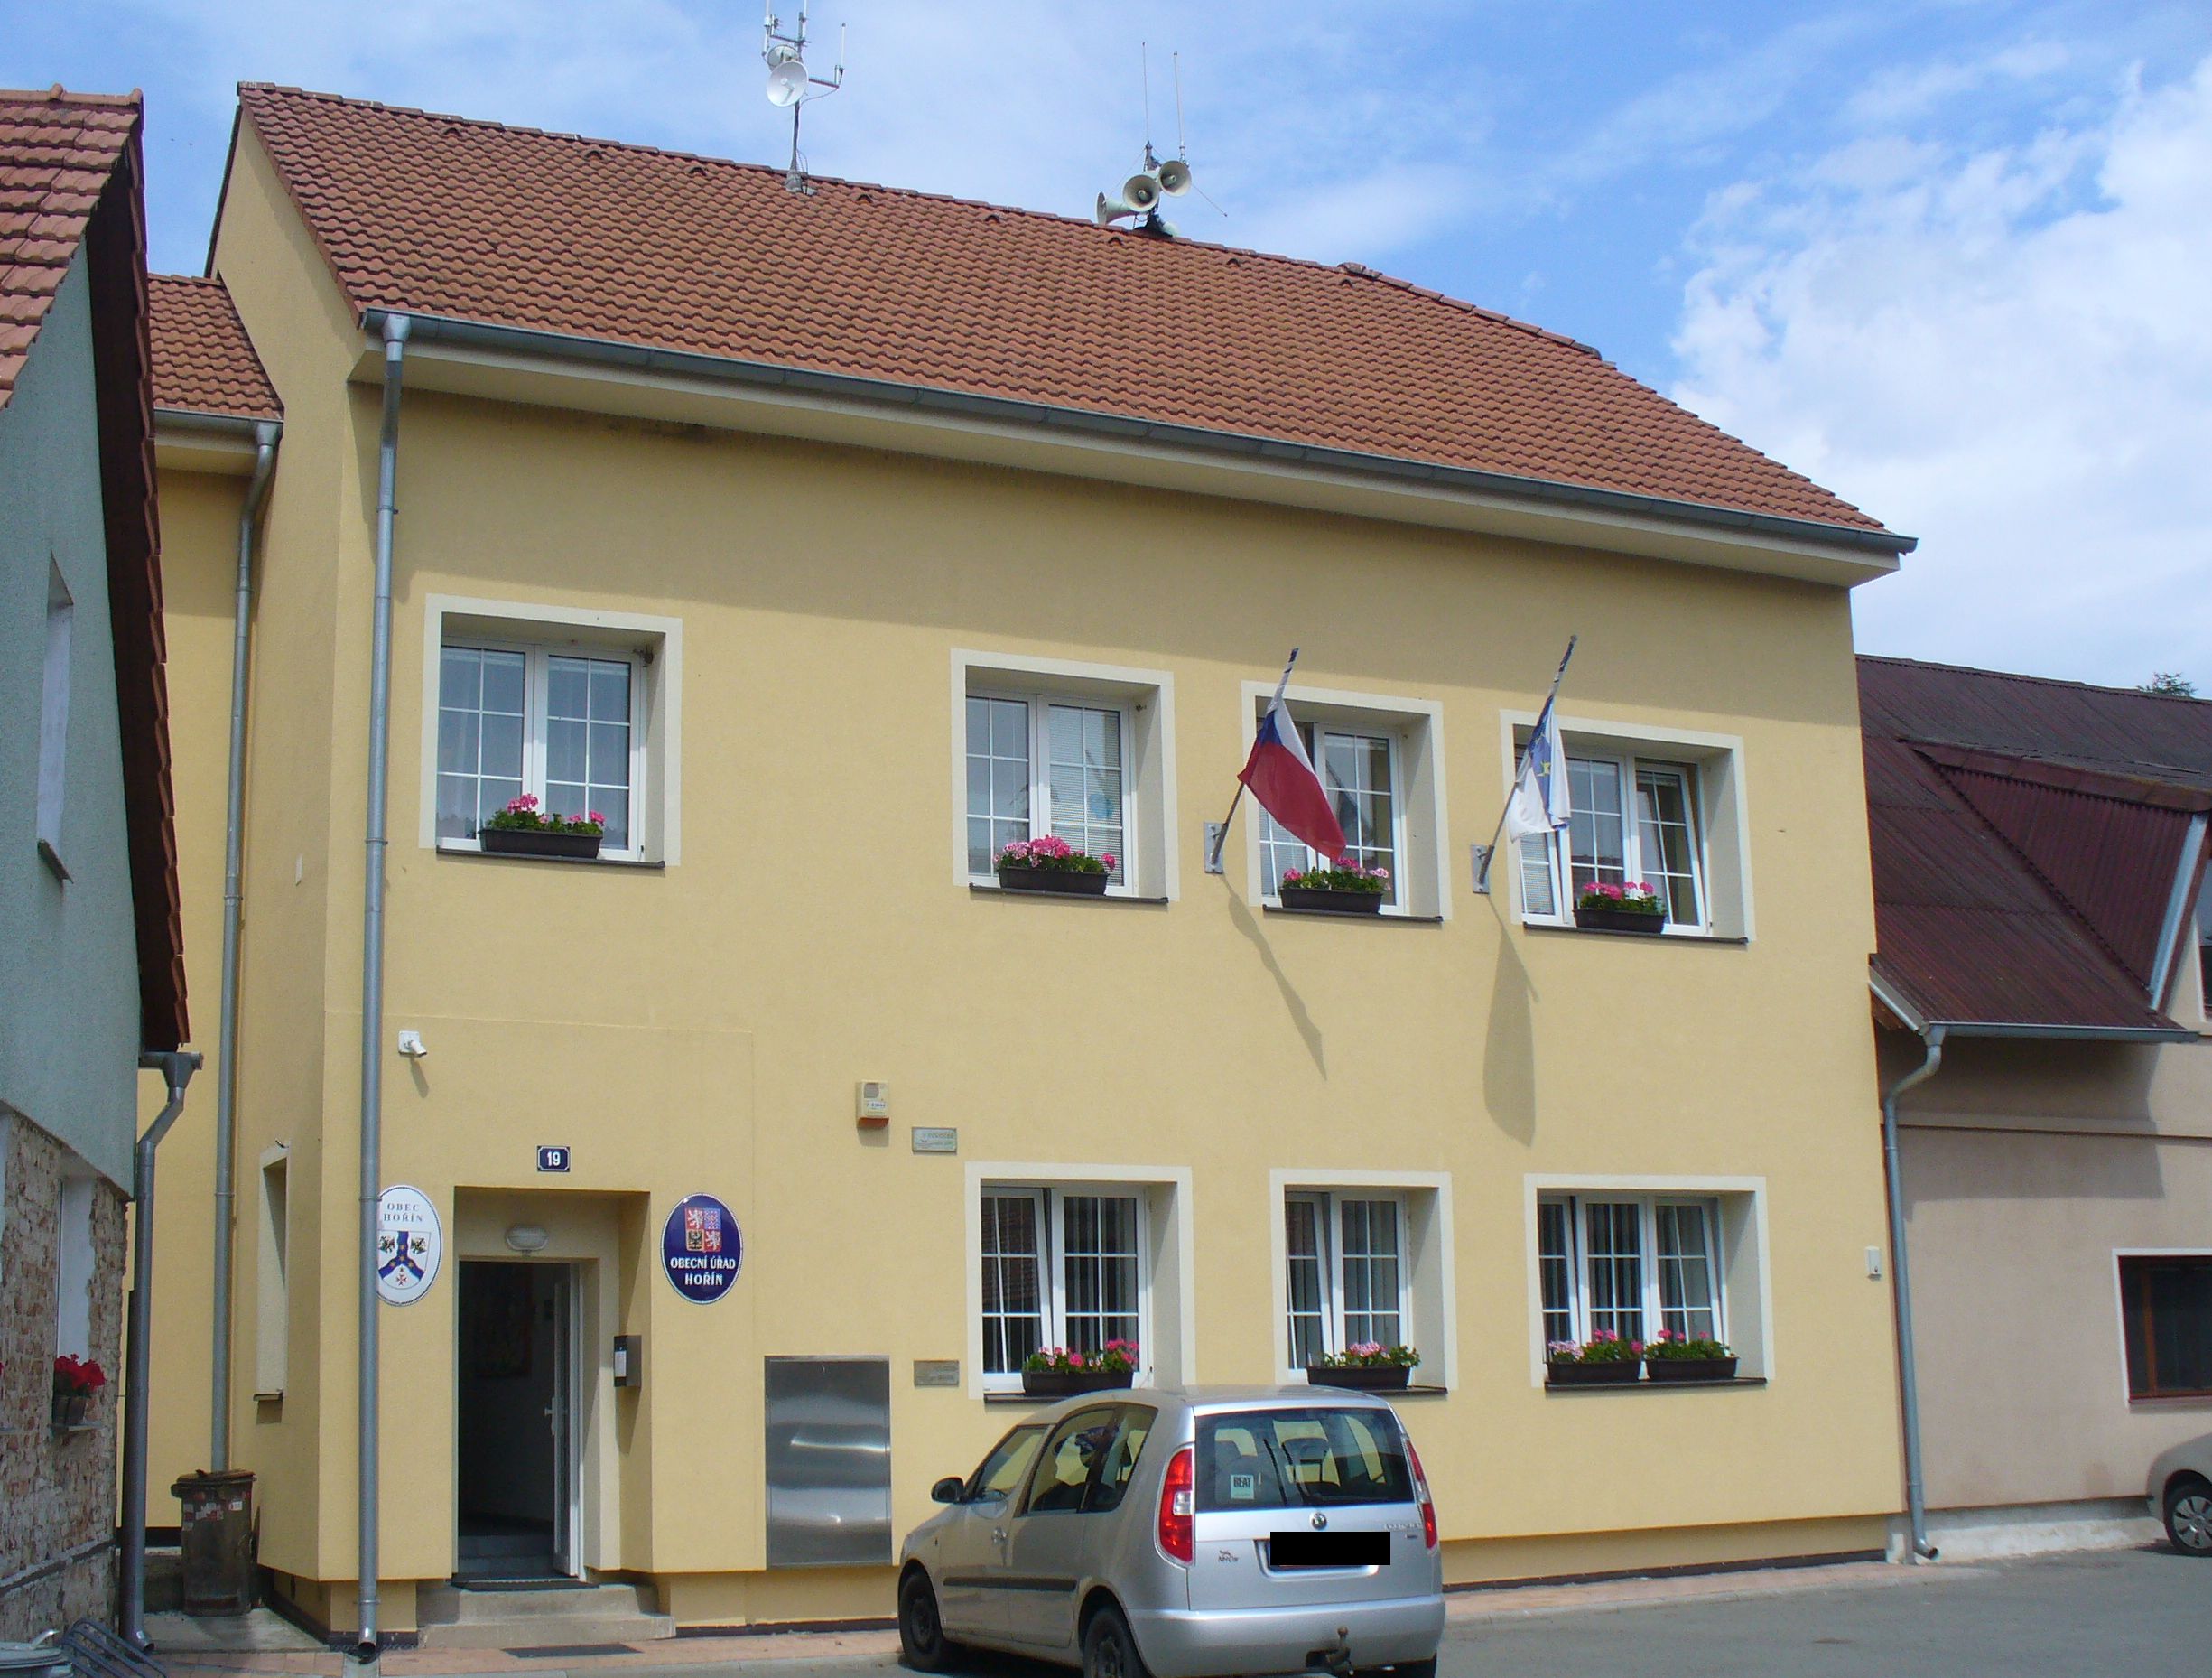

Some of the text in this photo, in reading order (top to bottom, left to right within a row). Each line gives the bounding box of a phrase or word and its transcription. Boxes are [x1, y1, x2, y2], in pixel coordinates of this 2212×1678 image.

[547, 1151, 561, 1166] 19
[387, 1203, 419, 1211] OBEC
[670, 1255, 736, 1270] OBECNÍ ÚŘAD
[684, 1271, 723, 1285] HOŘÍN
